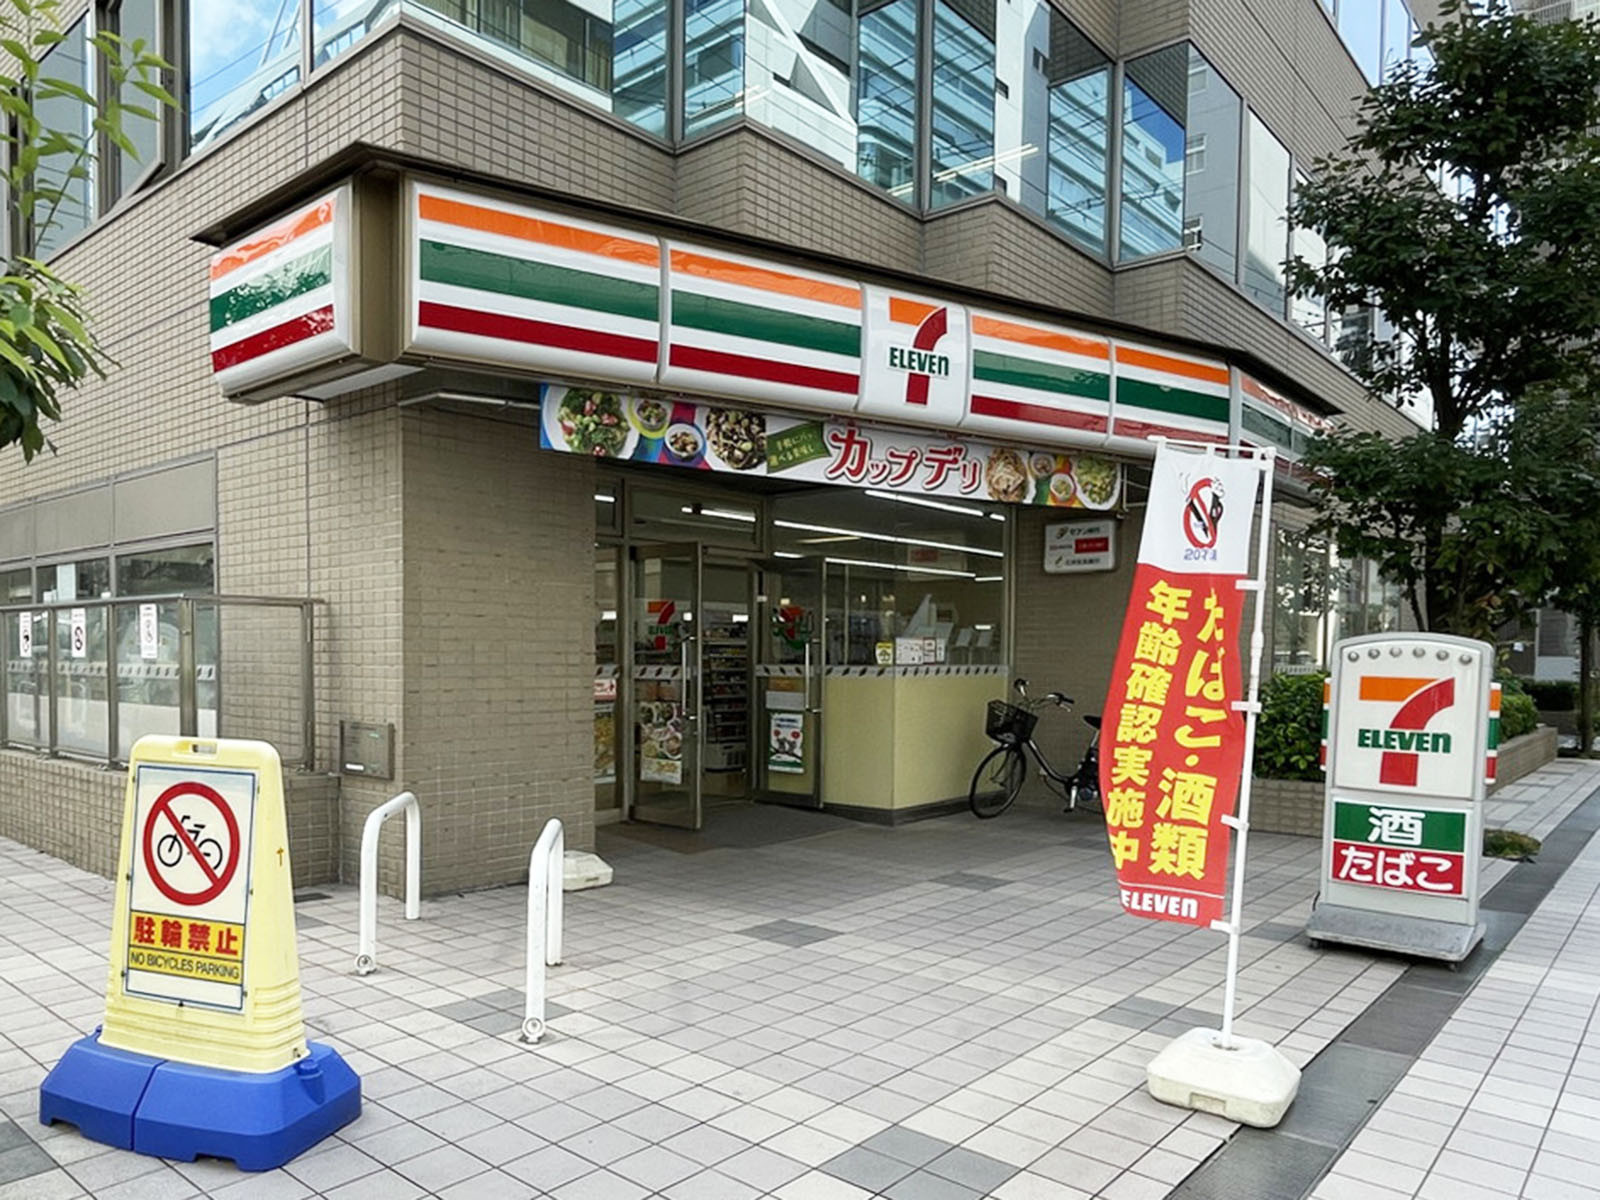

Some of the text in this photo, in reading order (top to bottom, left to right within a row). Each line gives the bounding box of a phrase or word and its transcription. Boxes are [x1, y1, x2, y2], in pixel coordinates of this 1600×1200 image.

[889, 296, 948, 405] 7
[889, 347, 949, 376] ELEVEN
[828, 427, 979, 491] カップデリ
[1106, 579, 1192, 870] 年齢確認実施中
[1357, 728, 1451, 754] ELEVEN
[1359, 676, 1455, 787] 7
[1367, 806, 1426, 846] 酒
[1339, 845, 1454, 891] たばこ
[1120, 889, 1198, 919] ELEVEN
[134, 915, 238, 956] 駐輪禁止
[131, 952, 240, 980] NO BICYCLES PARKING
